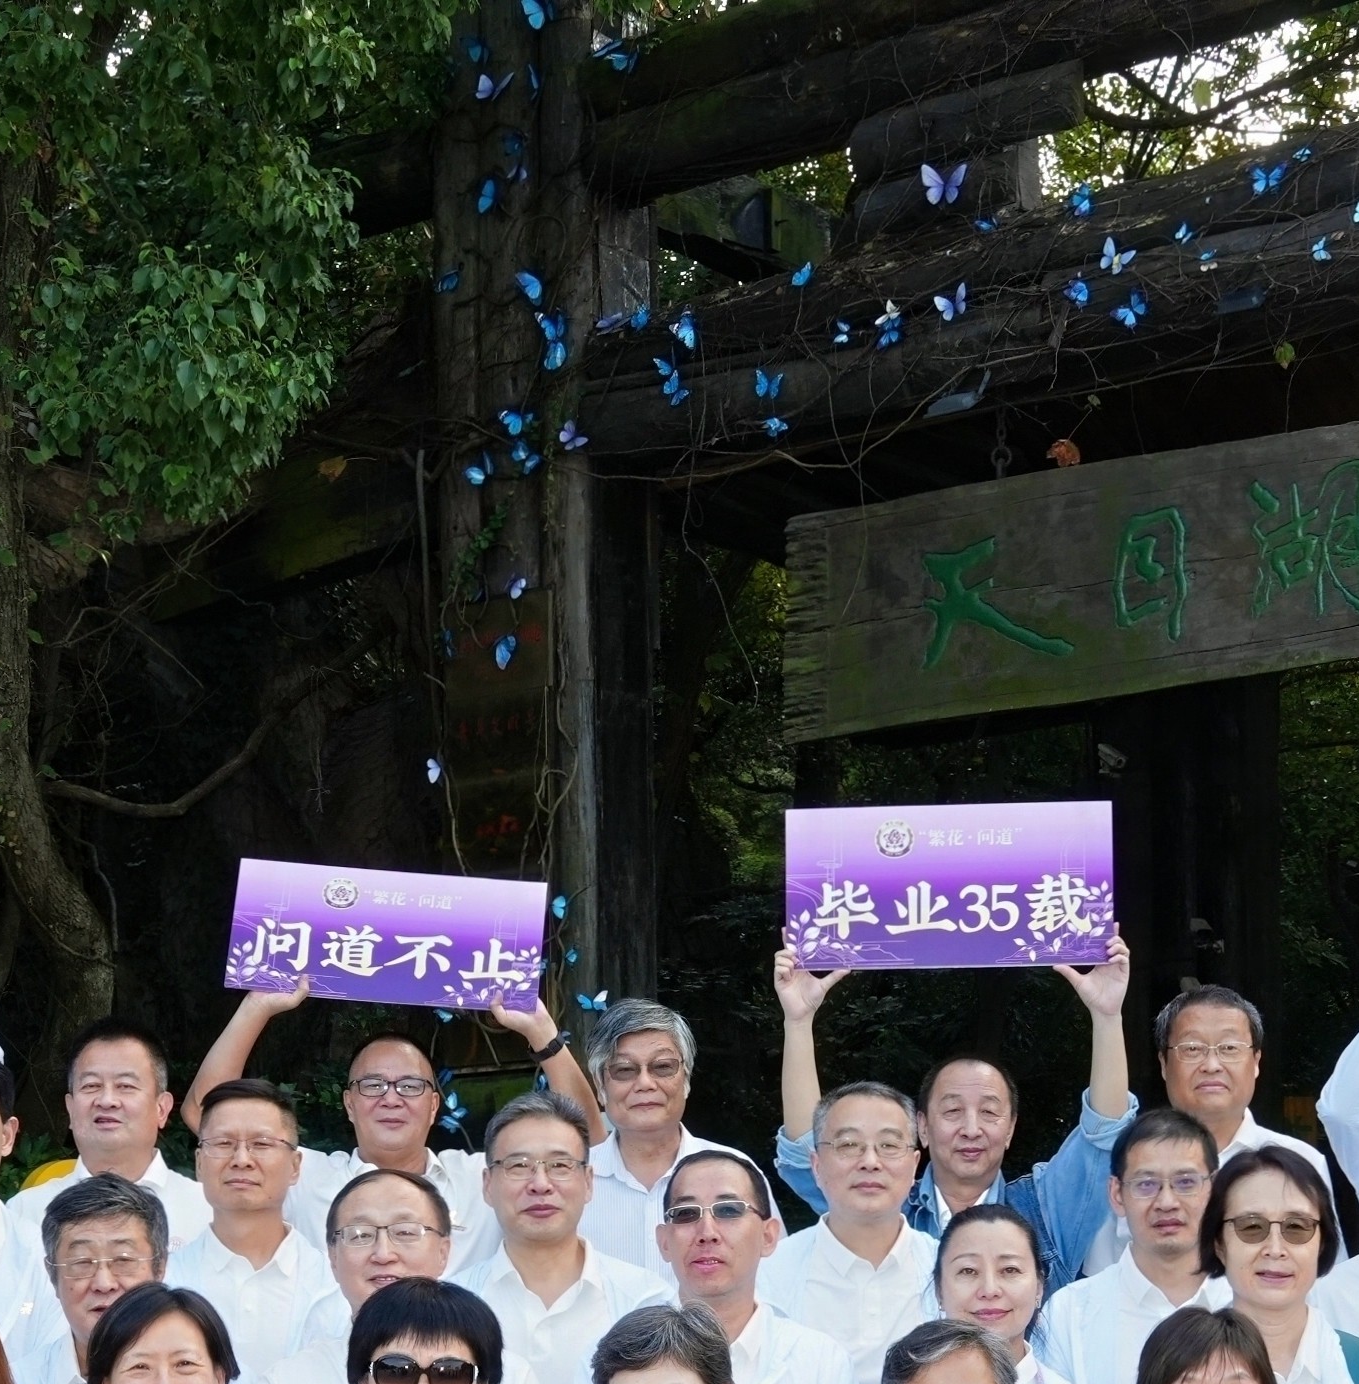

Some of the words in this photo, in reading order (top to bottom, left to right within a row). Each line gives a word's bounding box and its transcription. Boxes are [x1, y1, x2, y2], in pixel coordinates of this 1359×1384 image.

[813, 872, 1093, 940] 毕业35载
[251, 917, 524, 982] 问道不止
